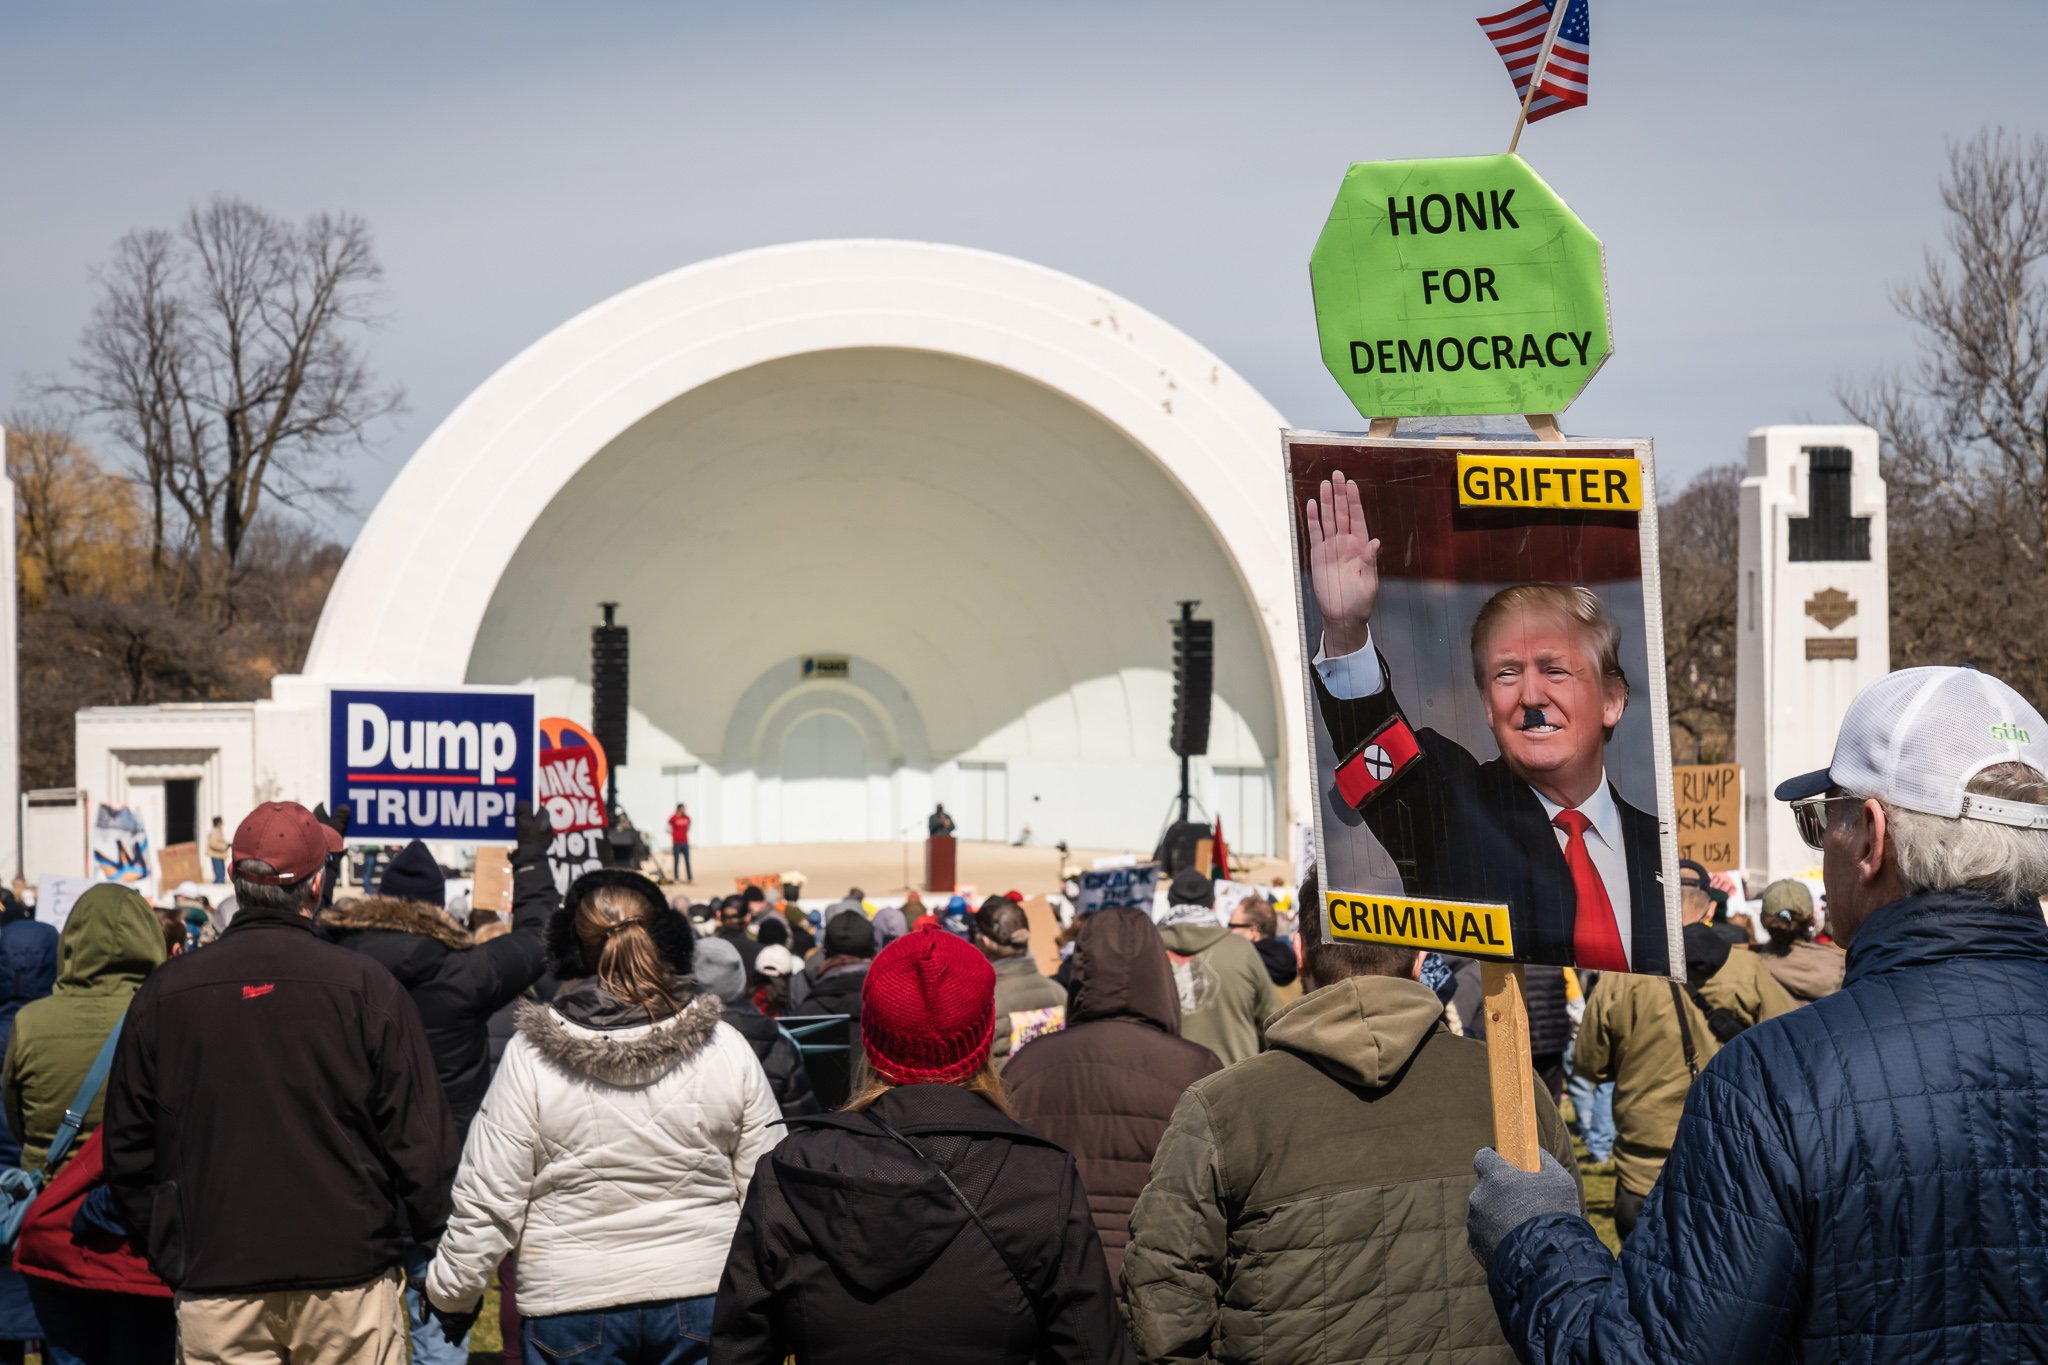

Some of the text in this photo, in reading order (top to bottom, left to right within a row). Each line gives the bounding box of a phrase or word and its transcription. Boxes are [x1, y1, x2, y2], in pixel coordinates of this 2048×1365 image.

[1388, 188, 1520, 236] HONK
[1422, 267, 1499, 305] FOR
[1350, 331, 1592, 375] DEMOCRACY
[1463, 465, 1630, 505] GRIFTER
[347, 702, 517, 786] Dump
[348, 788, 517, 828] TRUMP!
[541, 796, 604, 831] OVE
[546, 828, 605, 859] NOT
[1703, 842, 1732, 864] USA
[1329, 899, 1505, 946] CRIMINAL
